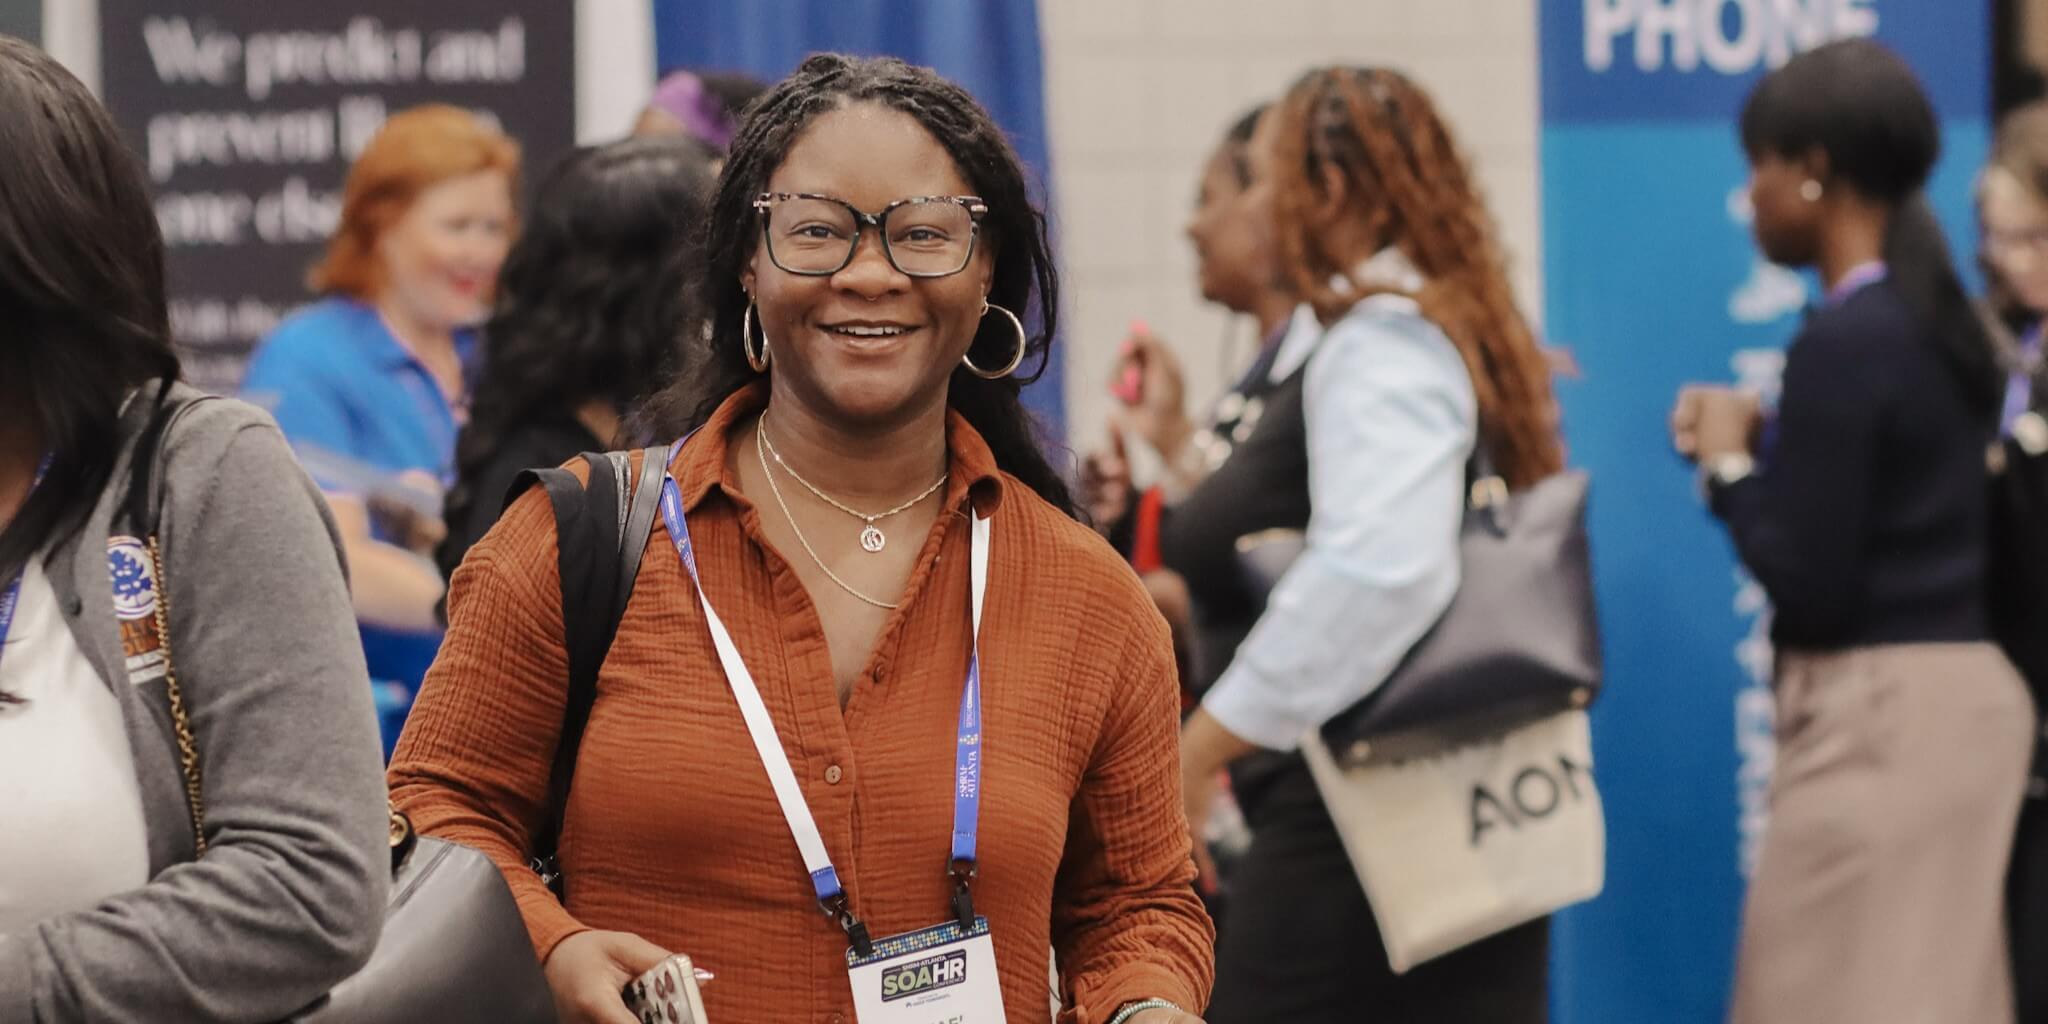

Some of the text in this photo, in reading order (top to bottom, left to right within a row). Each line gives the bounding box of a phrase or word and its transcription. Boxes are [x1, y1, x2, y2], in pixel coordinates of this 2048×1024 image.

[143, 15, 525, 99] We predict and
[148, 112, 334, 182] prevent
[883, 957, 964, 995] SOAHR
